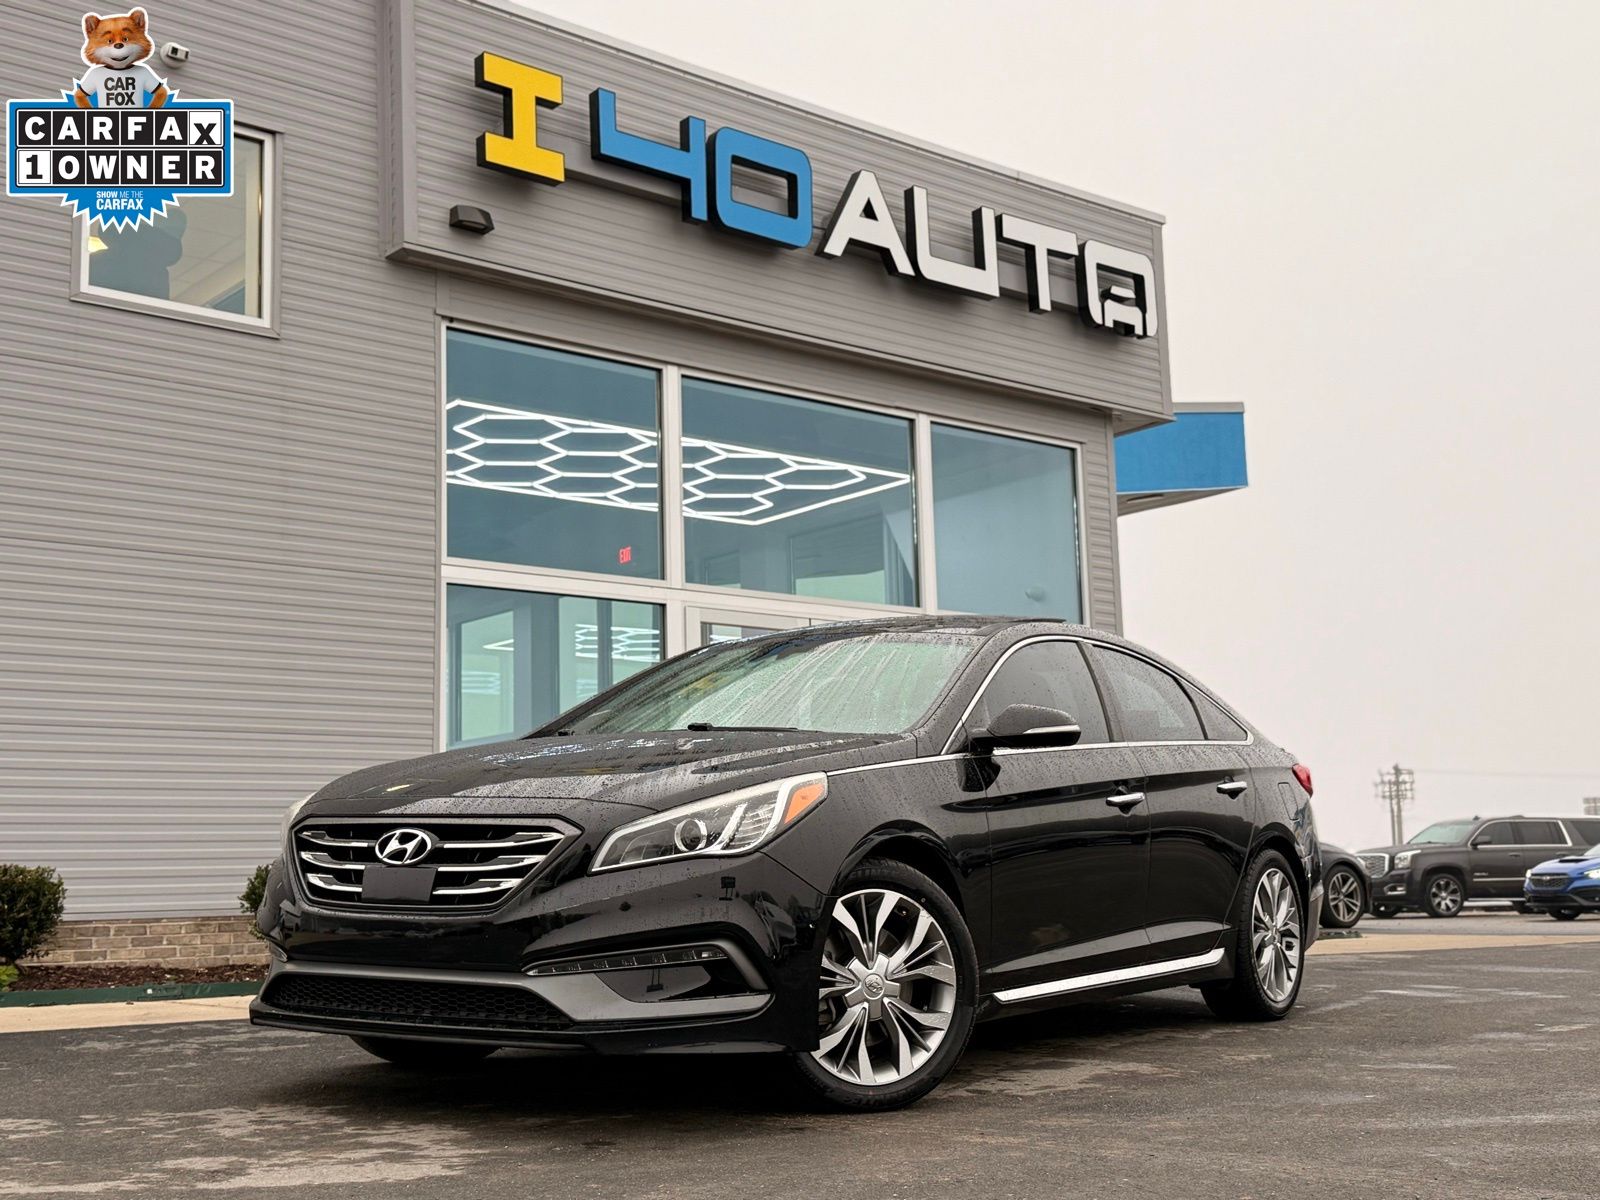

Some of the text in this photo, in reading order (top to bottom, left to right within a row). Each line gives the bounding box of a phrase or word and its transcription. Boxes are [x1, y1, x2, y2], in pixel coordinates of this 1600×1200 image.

[475, 51, 1157, 339] I 40 AUTO
